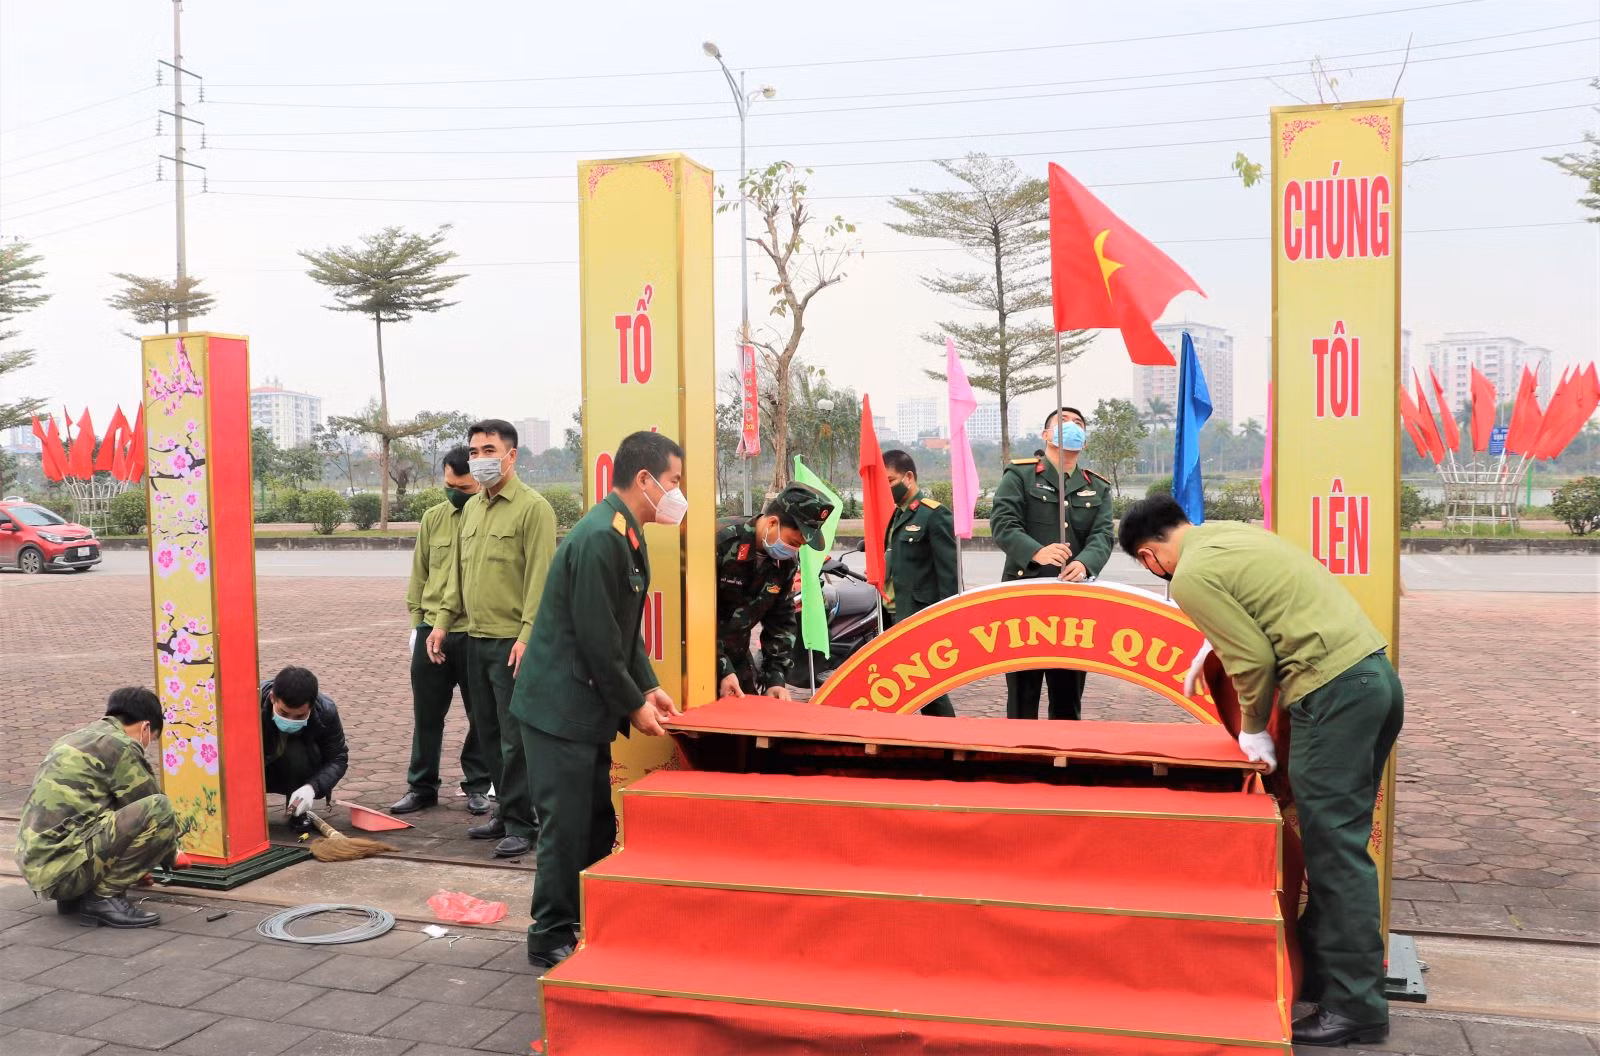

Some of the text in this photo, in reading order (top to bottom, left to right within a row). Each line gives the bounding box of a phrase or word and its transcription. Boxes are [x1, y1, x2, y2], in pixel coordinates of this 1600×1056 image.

[1283, 161, 1390, 261] CHÚNG
[615, 284, 652, 384] TỔ
[1312, 320, 1360, 418] TÔI
[1312, 479, 1369, 575] LÊN
[968, 615, 1097, 653] VINH
